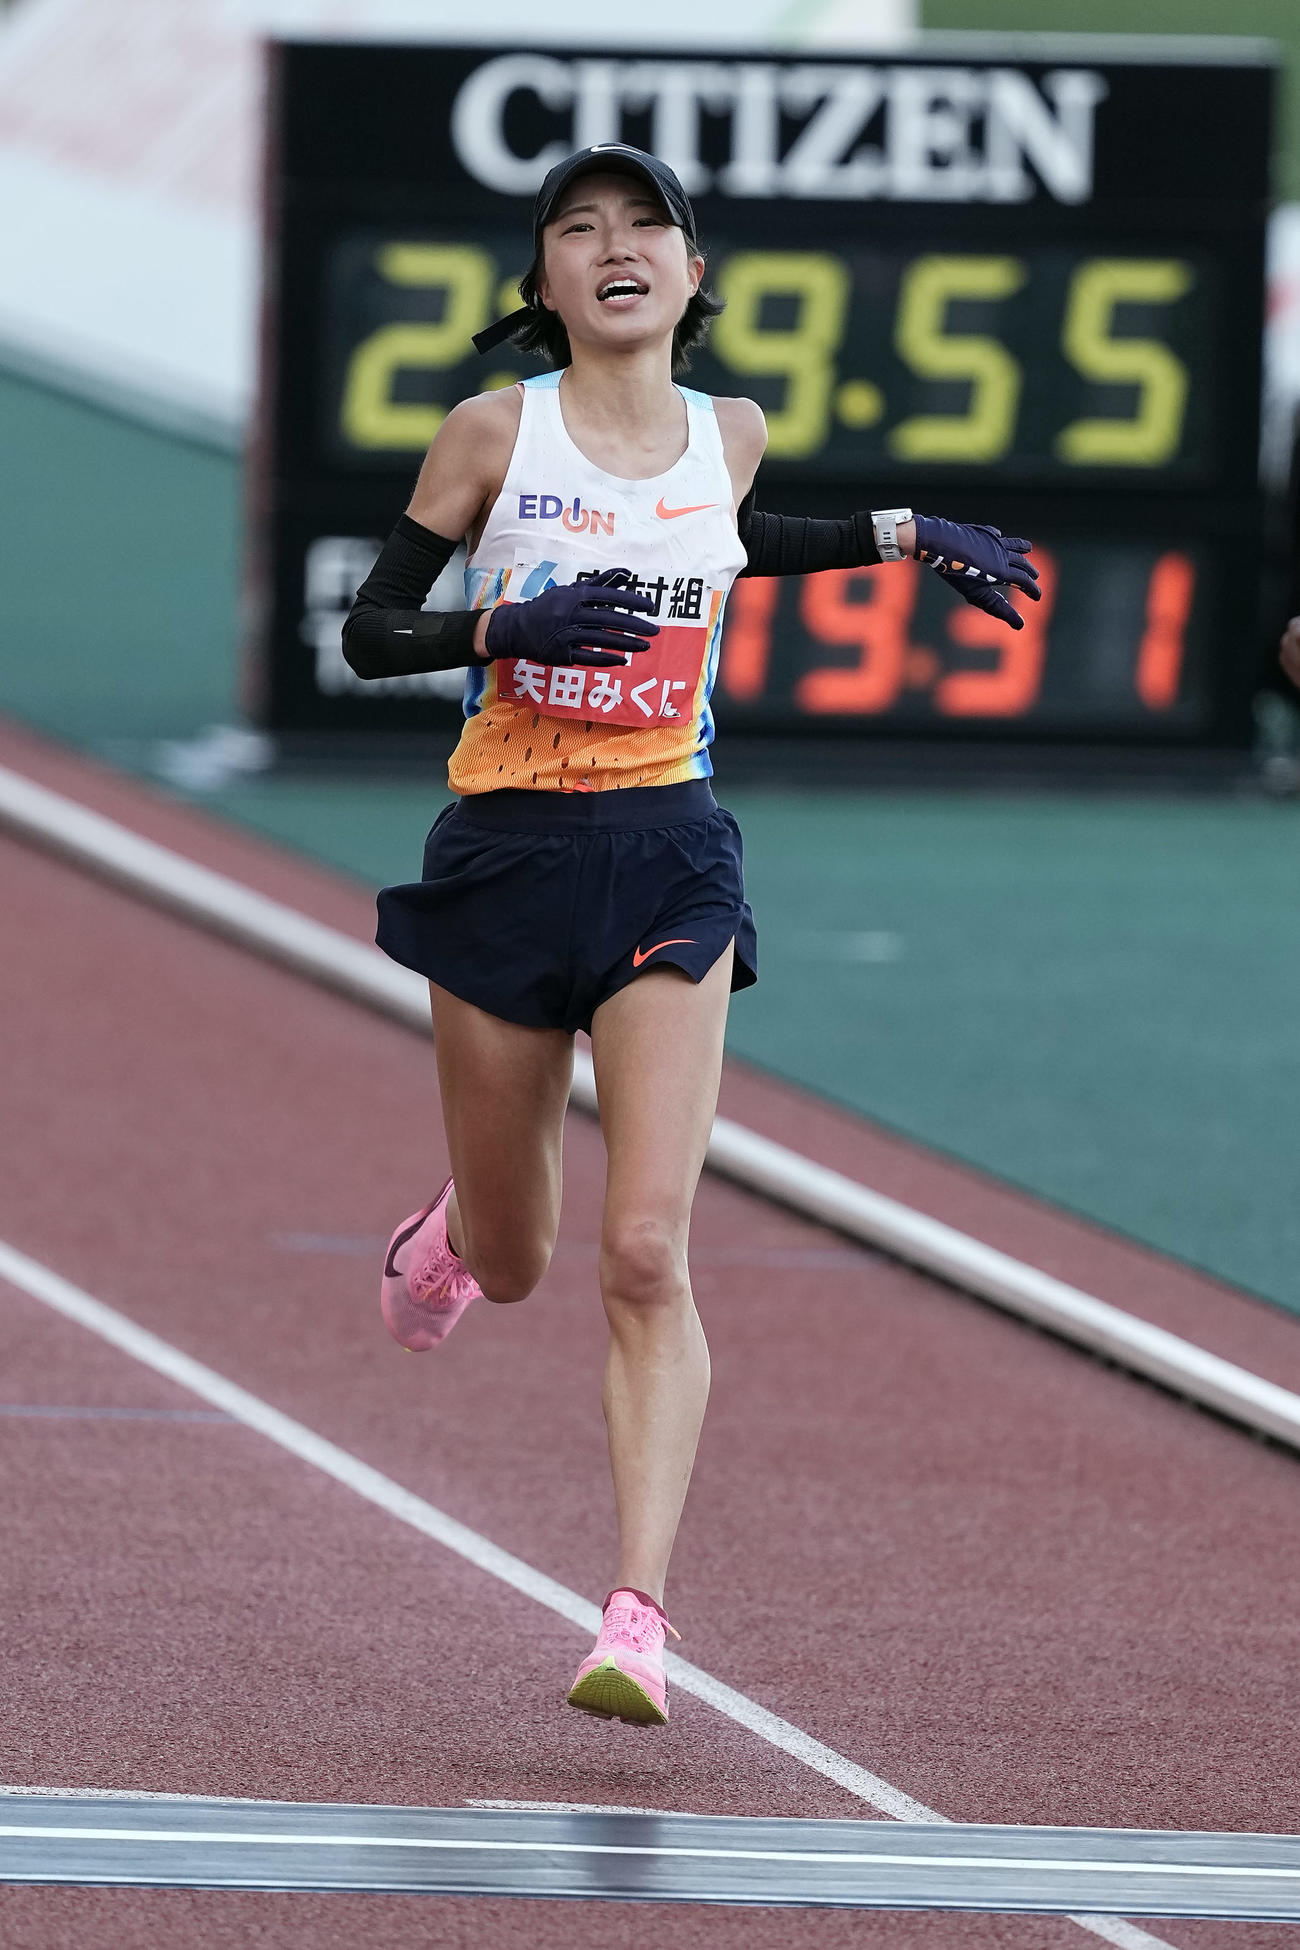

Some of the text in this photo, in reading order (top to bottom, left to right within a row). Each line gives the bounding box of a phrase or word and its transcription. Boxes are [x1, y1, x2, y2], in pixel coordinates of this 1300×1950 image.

[450, 52, 1108, 206] CITIZEN
[518, 494, 615, 536] EDION
[575, 569, 705, 620] 村組
[512, 658, 686, 718] 矢田みくに
